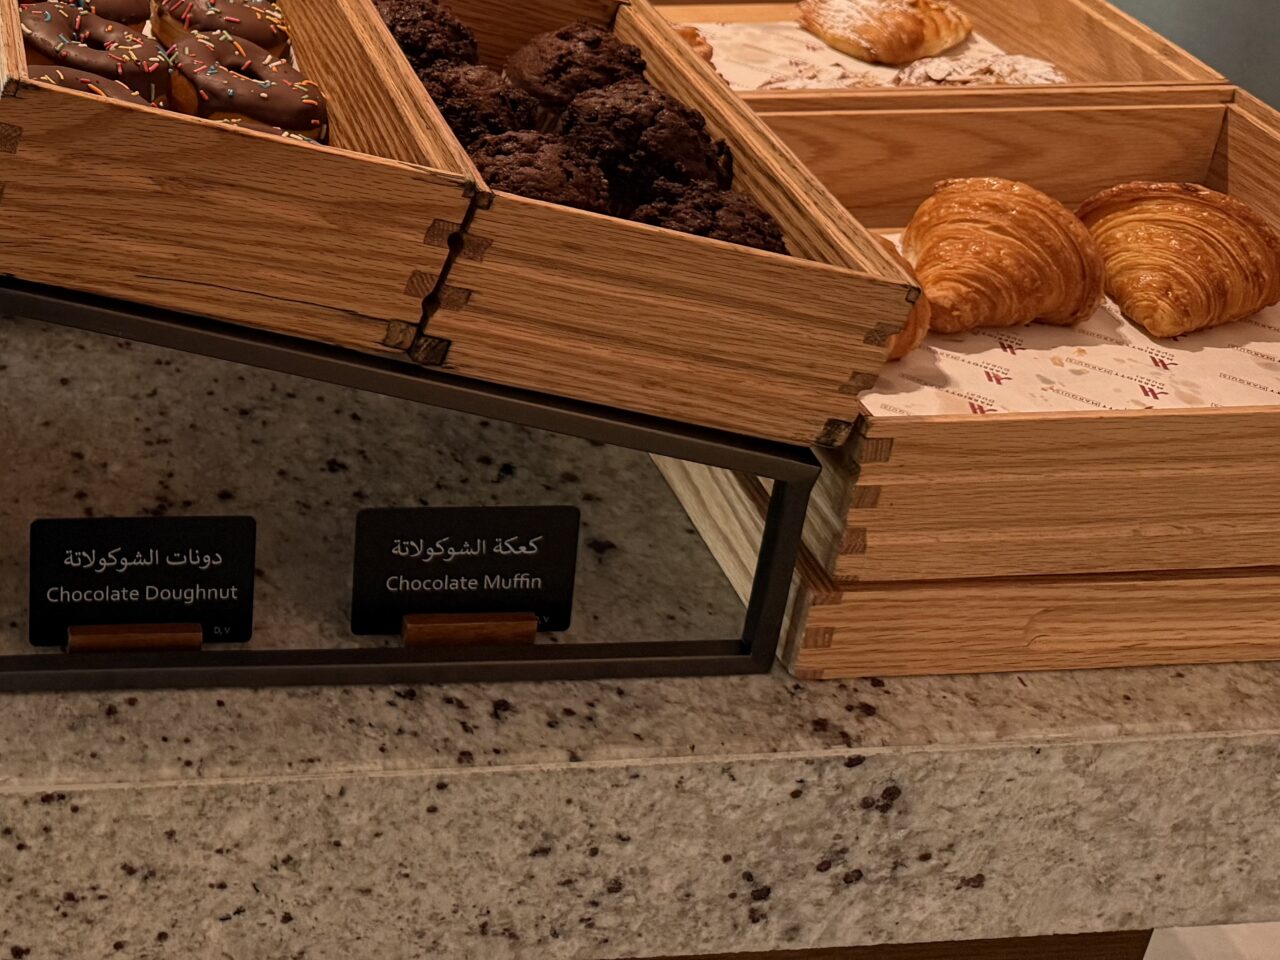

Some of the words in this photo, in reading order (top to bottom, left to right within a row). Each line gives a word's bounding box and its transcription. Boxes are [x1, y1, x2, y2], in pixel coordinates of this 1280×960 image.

[391, 537, 487, 563] الشوكولاتة
[492, 536, 543, 556] كعكة
[63, 547, 159, 573] الشوكولاتة
[166, 547, 222, 569] دونات
[386, 574, 478, 592] Chocolate
[483, 572, 542, 590] Muffin
[46, 586, 139, 603] Chocolate
[145, 584, 238, 604] Doughnut
